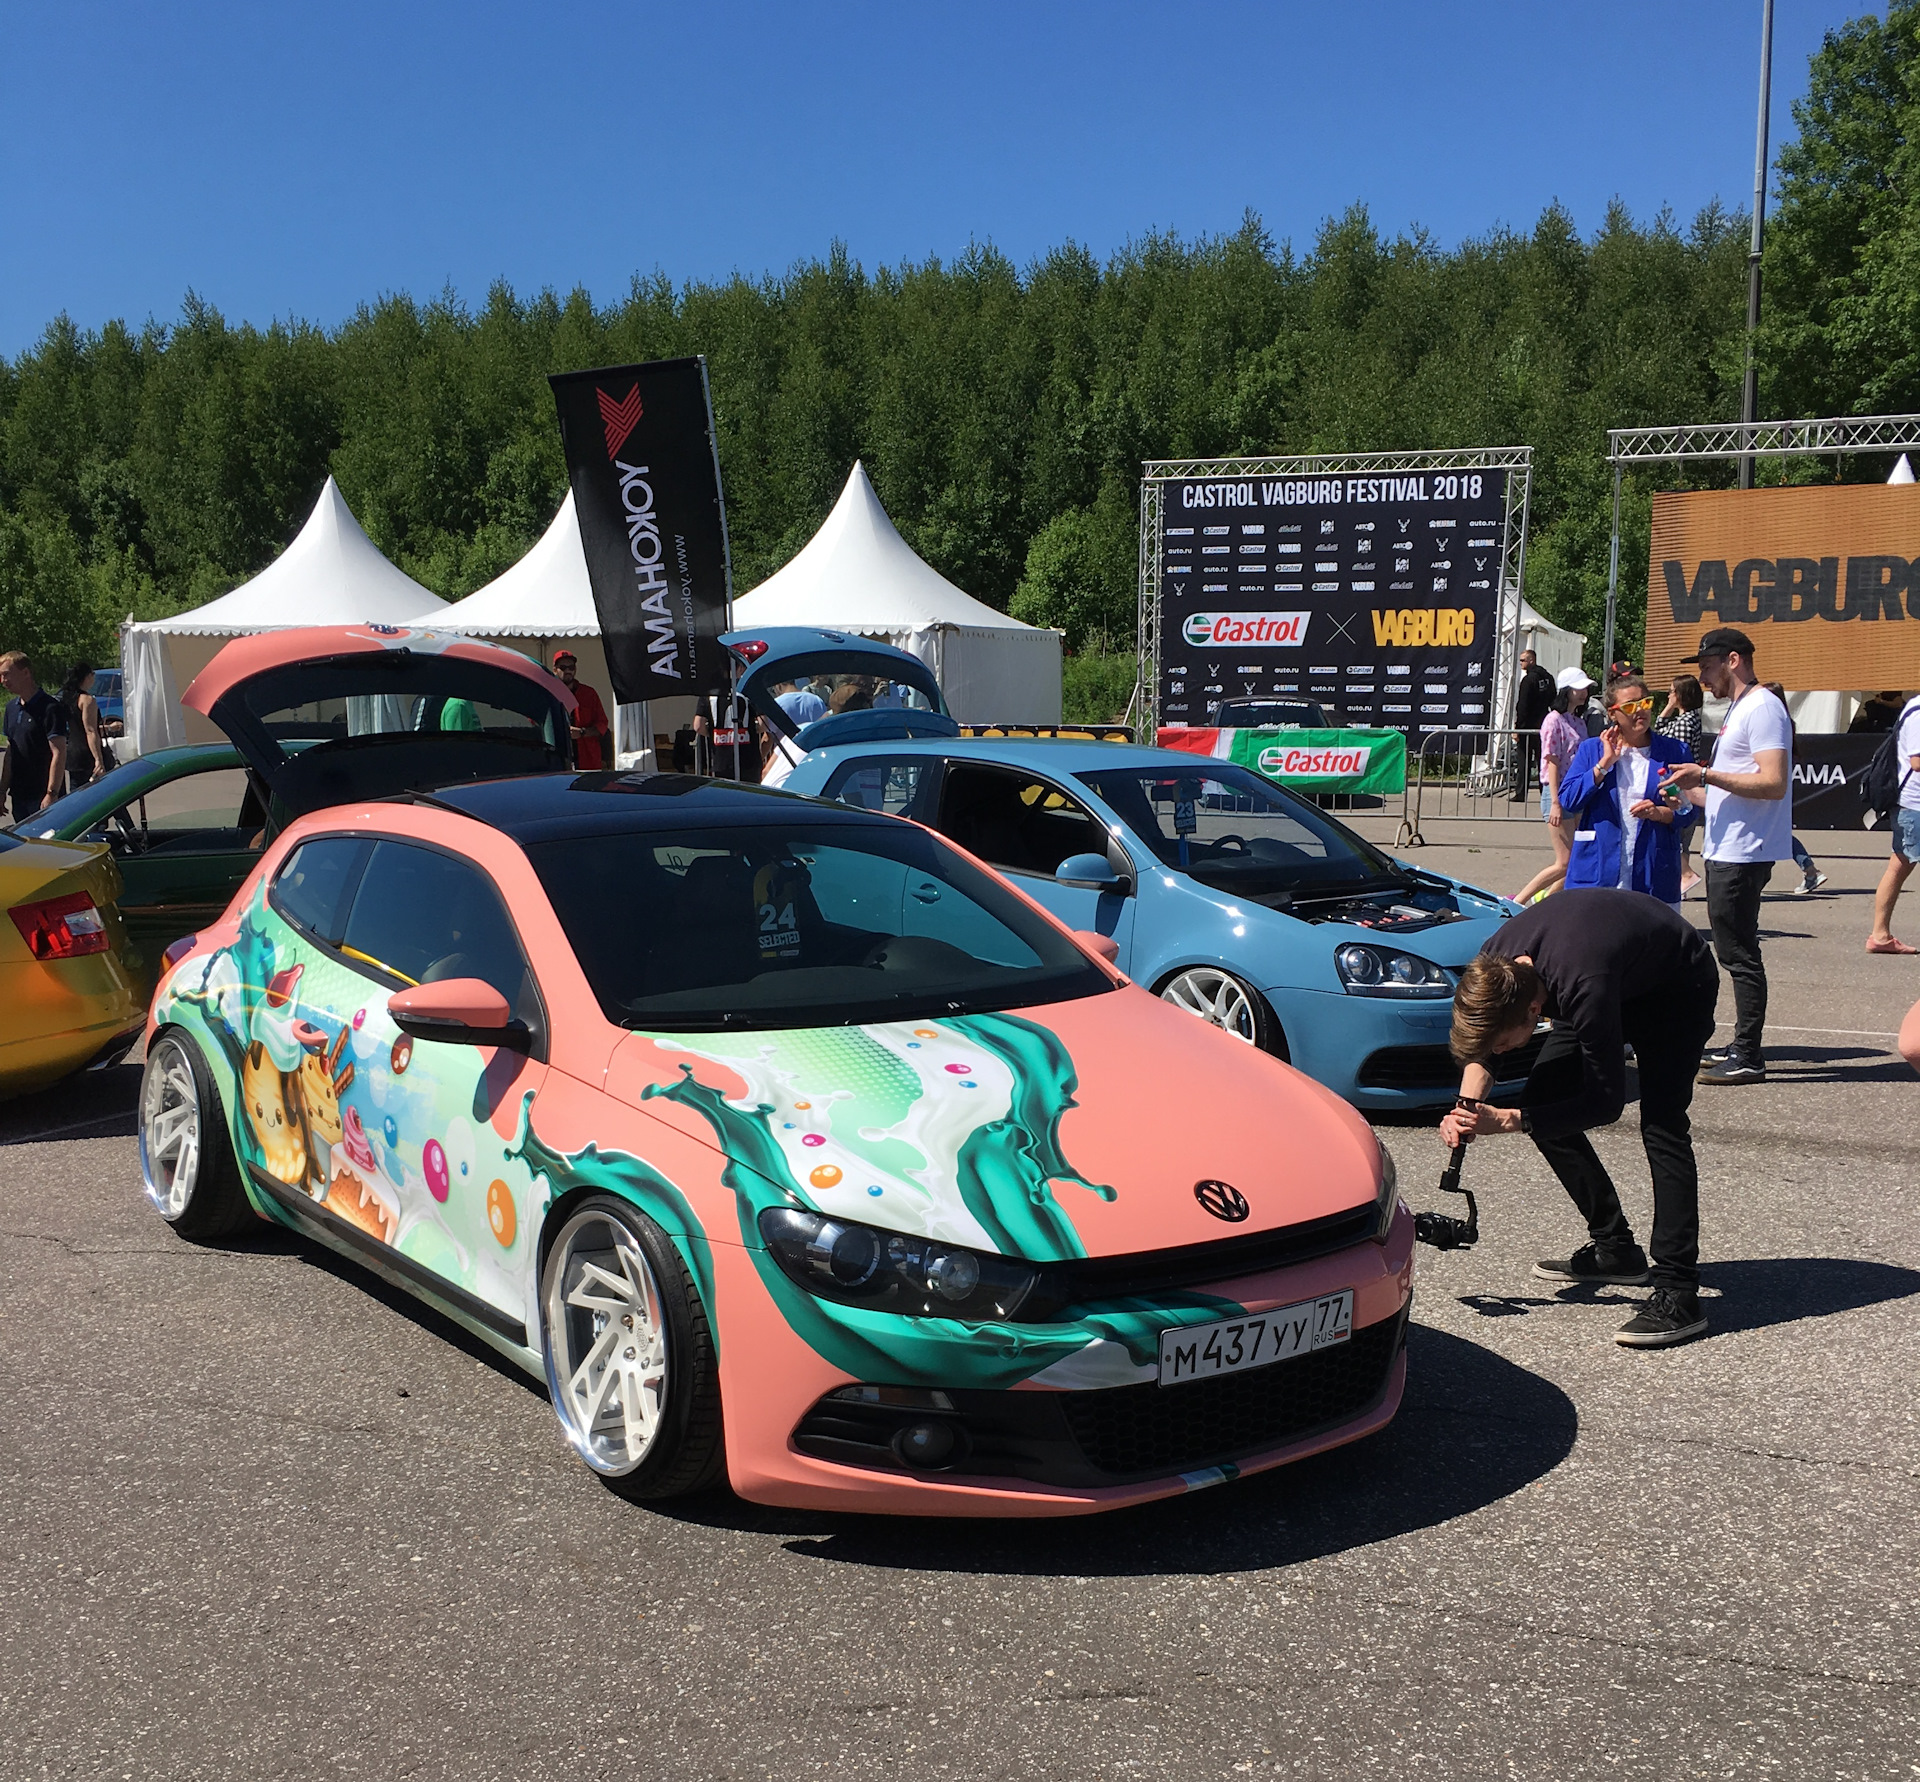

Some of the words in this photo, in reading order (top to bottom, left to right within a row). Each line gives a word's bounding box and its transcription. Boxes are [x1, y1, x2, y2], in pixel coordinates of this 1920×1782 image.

[1183, 483, 1258, 508] CASTROL
[1261, 480, 1342, 505] VAGBURG
[1346, 477, 1429, 503] FESTIVAL
[1433, 475, 1483, 500] 2018
[1662, 555, 1920, 623] VAGBUR
[1213, 616, 1300, 642] Castrol
[1371, 608, 1475, 647] VAGBURG
[1284, 750, 1362, 772] Castrol
[1176, 801, 1194, 818] 23
[759, 902, 796, 931] 24
[758, 931, 800, 949] SELECTED
[1318, 1297, 1344, 1332] 77
[1314, 1329, 1334, 1345] RUS
